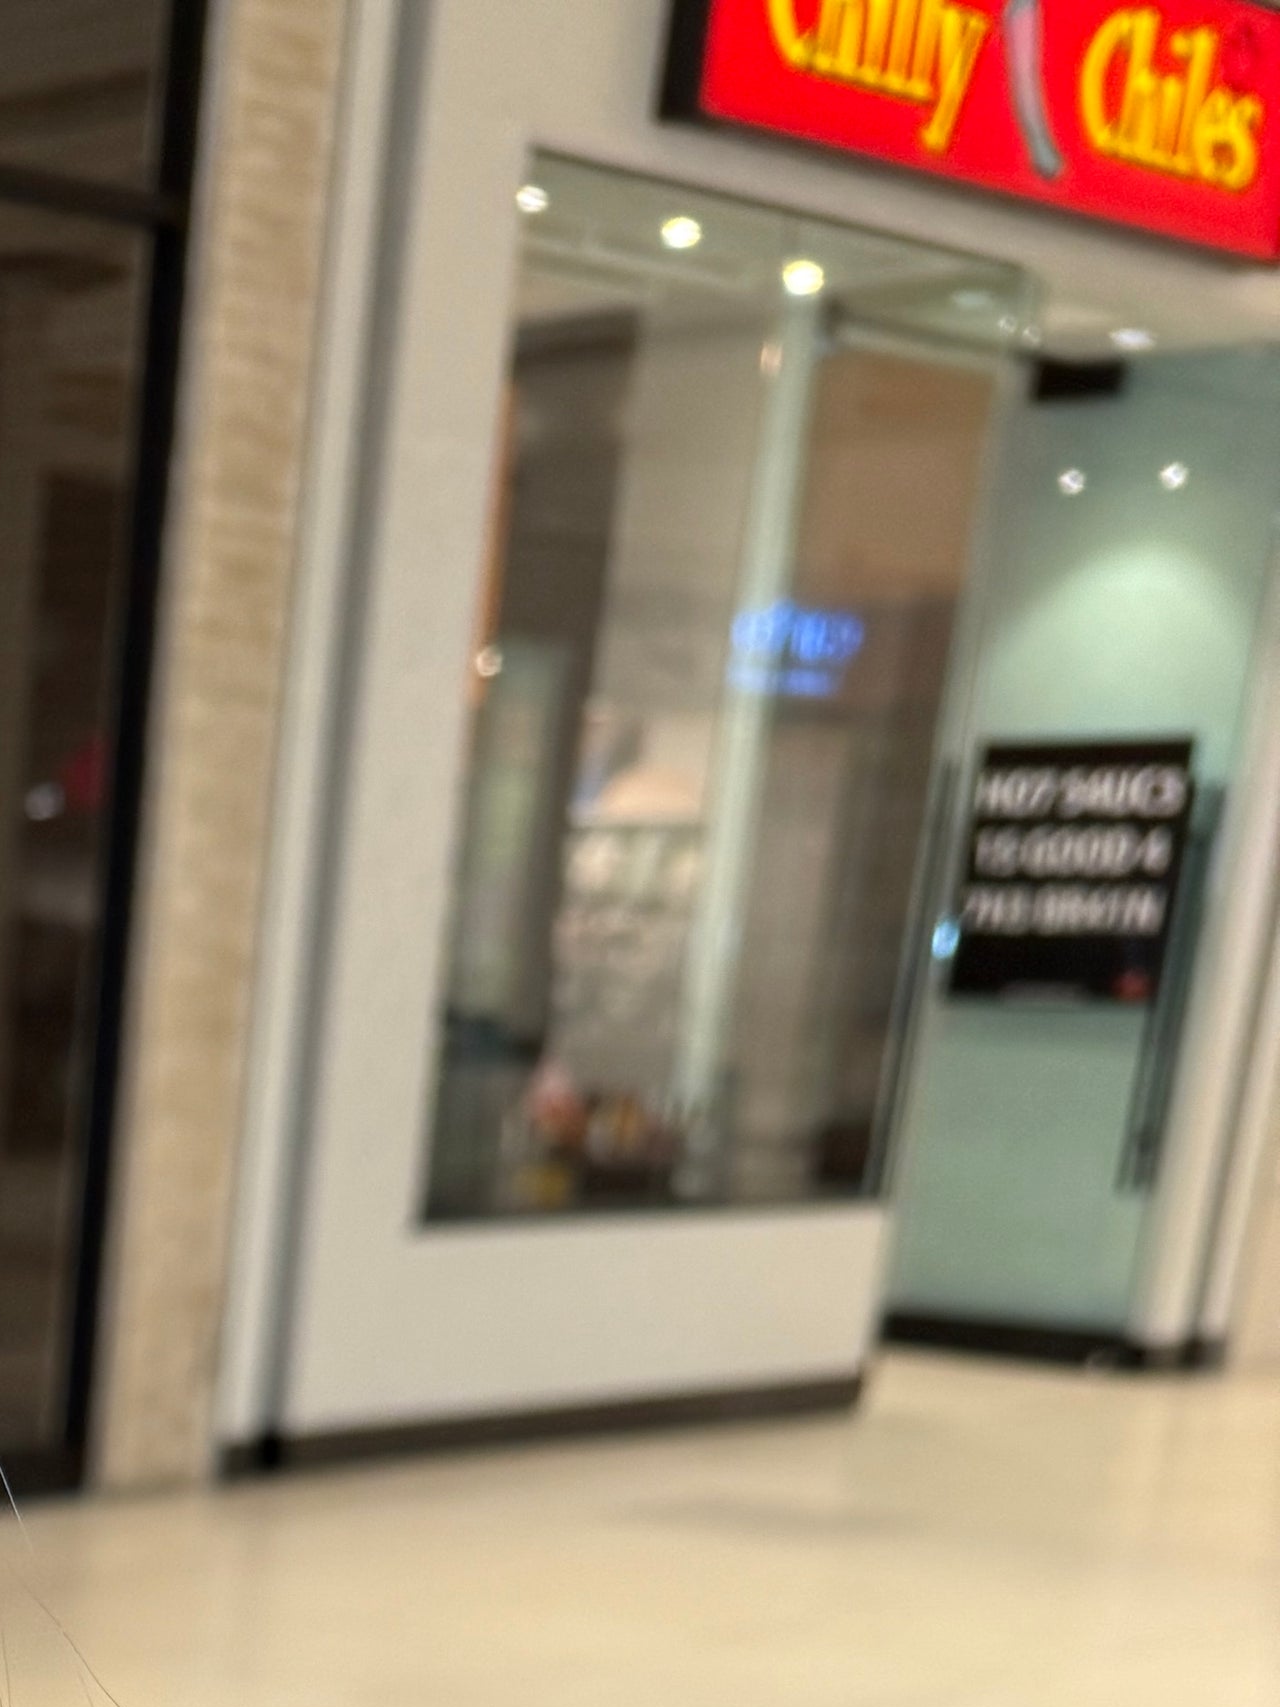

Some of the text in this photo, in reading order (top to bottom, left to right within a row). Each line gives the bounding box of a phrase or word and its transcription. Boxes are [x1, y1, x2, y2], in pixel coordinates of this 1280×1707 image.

[1079, 9, 1261, 189] Chiles
[976, 767, 1057, 818] HOT
[1020, 823, 1140, 877] GOOD
